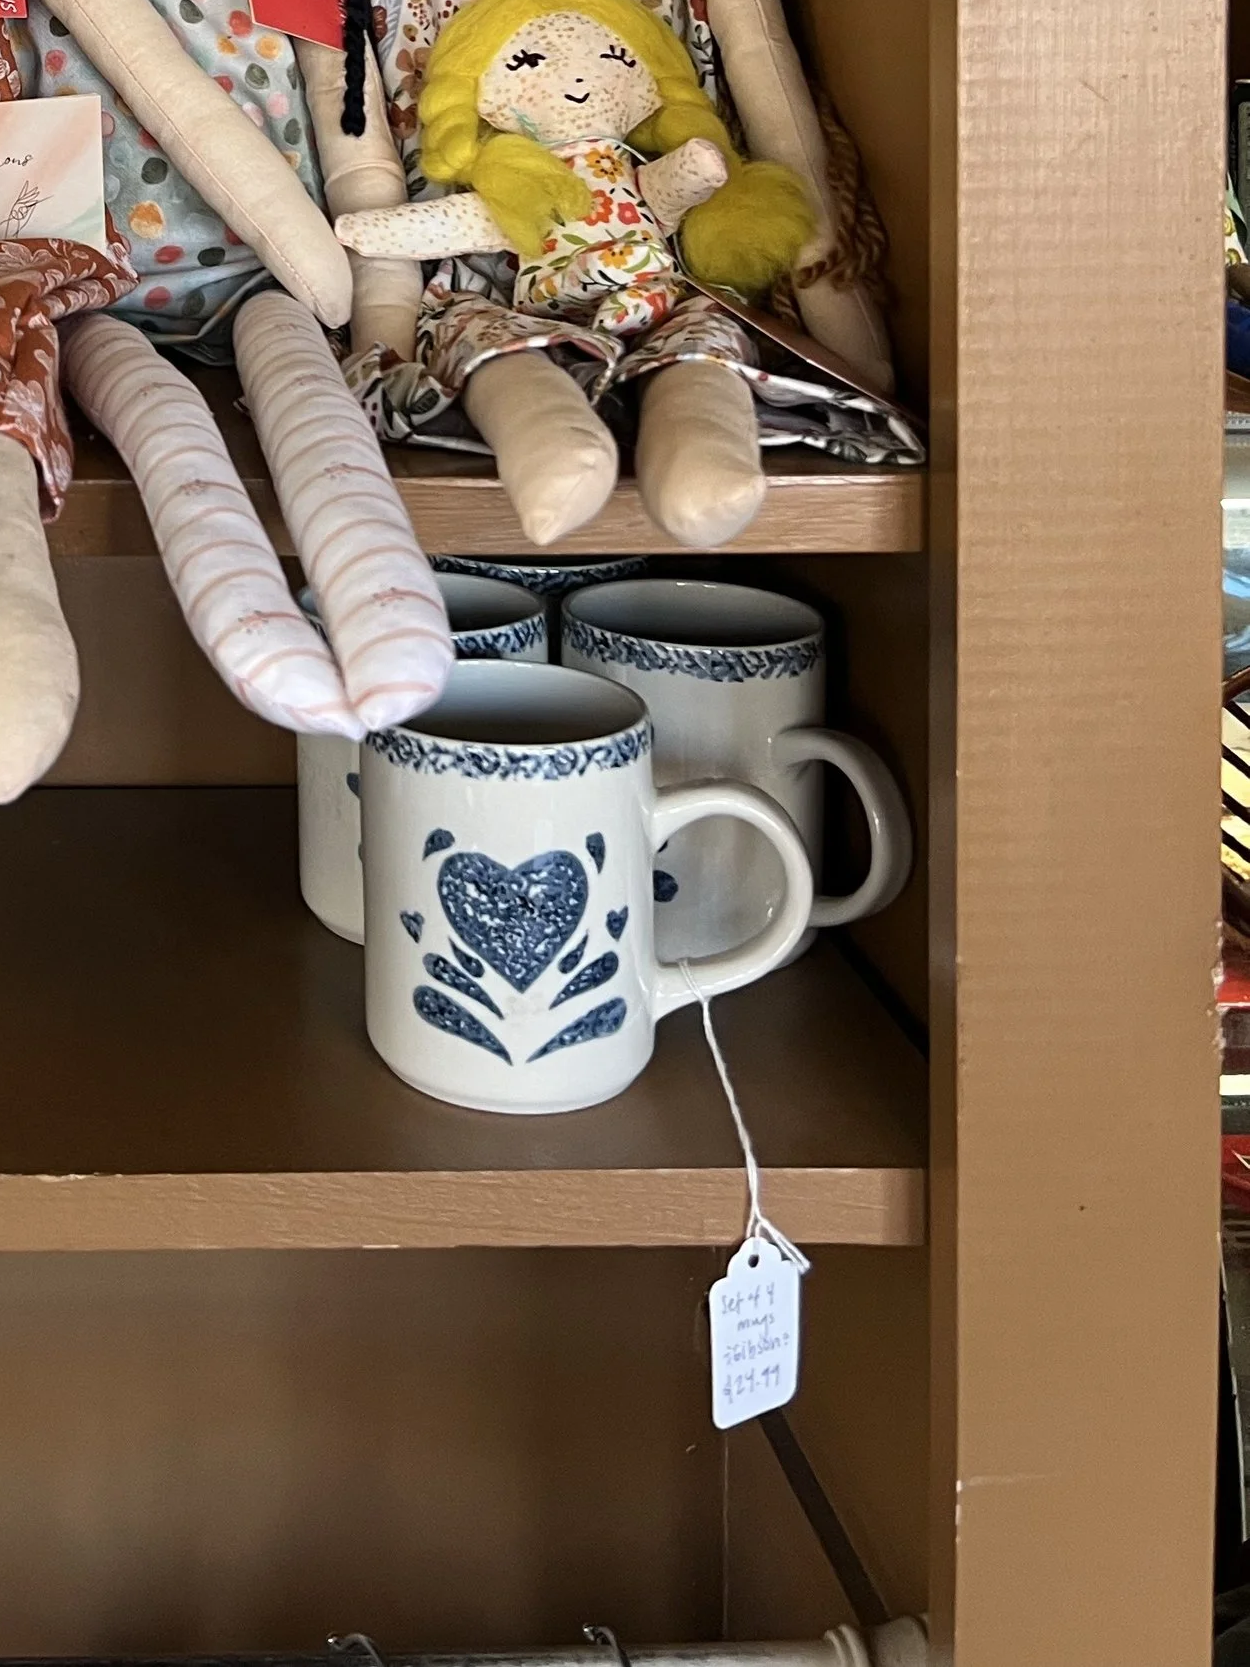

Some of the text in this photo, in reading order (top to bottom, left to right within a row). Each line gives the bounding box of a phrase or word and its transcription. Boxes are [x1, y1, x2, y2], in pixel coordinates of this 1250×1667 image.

[722, 1281, 775, 1315] Set of 4
[737, 1312, 776, 1338] mugs
